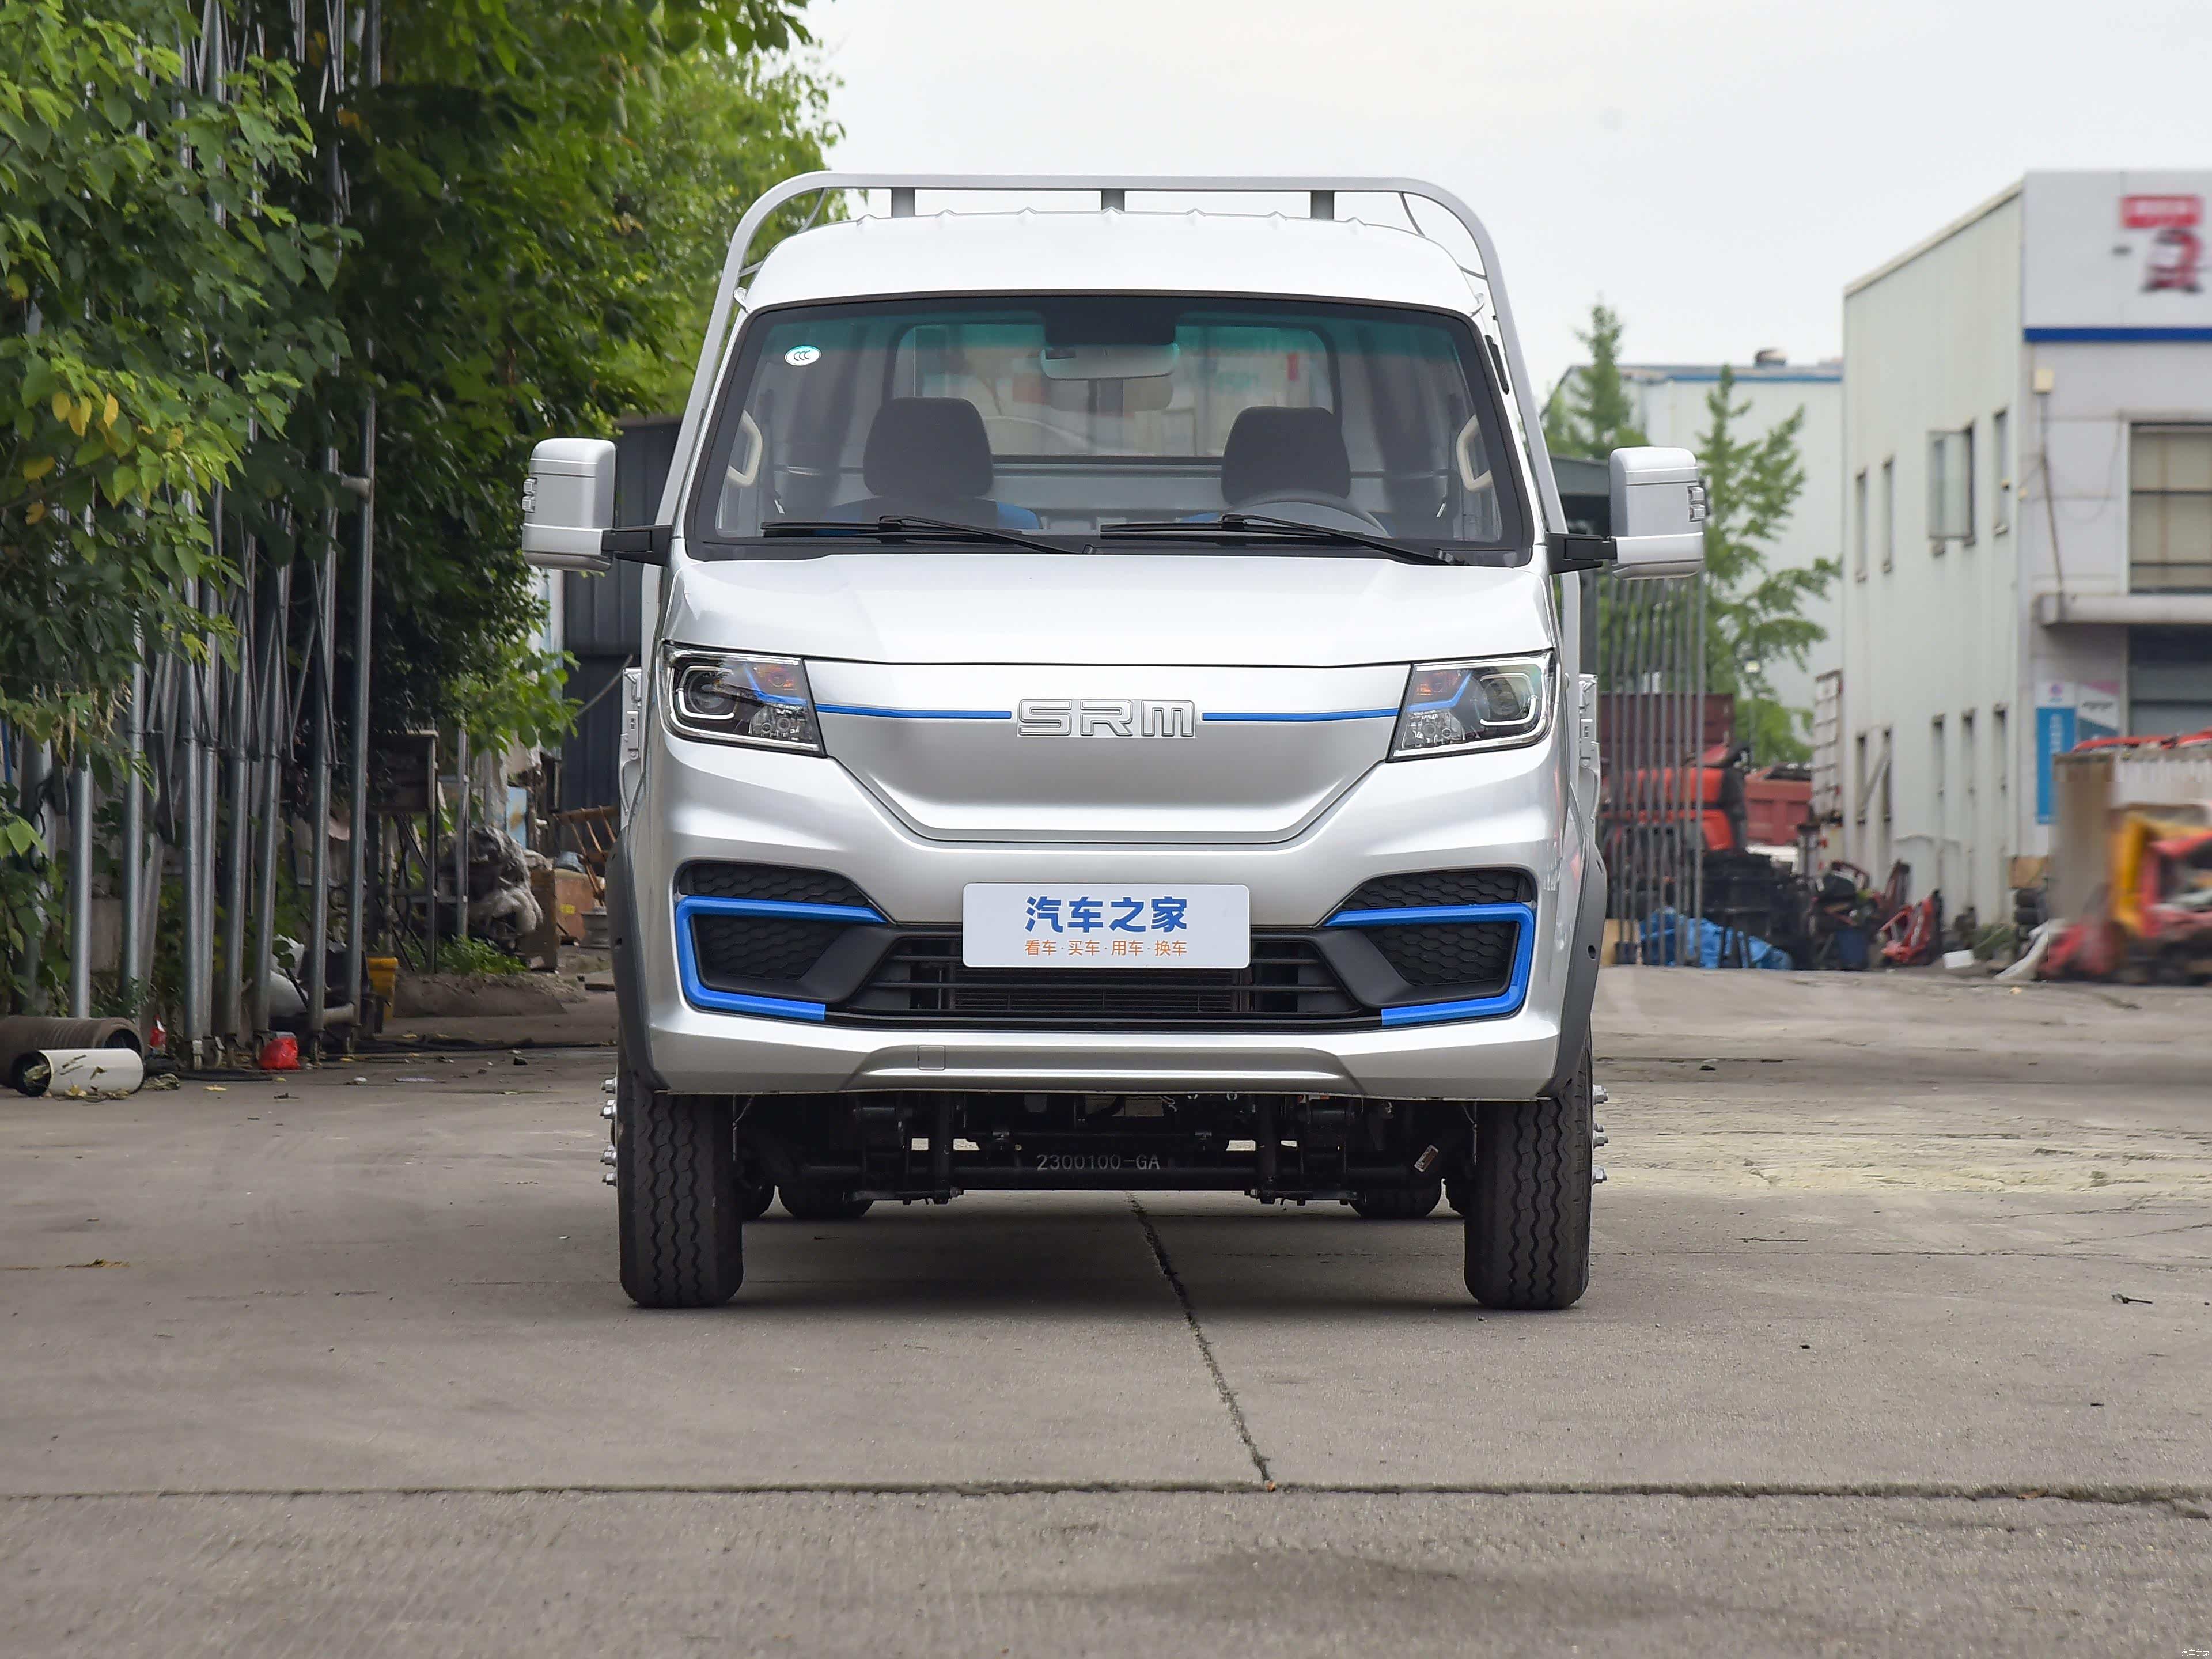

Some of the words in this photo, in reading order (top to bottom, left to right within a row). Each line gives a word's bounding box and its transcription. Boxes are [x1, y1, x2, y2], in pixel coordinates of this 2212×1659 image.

[1018, 698, 1196, 737] SRM
[1024, 896, 1188, 933] 汽车之家
[1036, 1154, 1161, 1171] 2300100-GA
